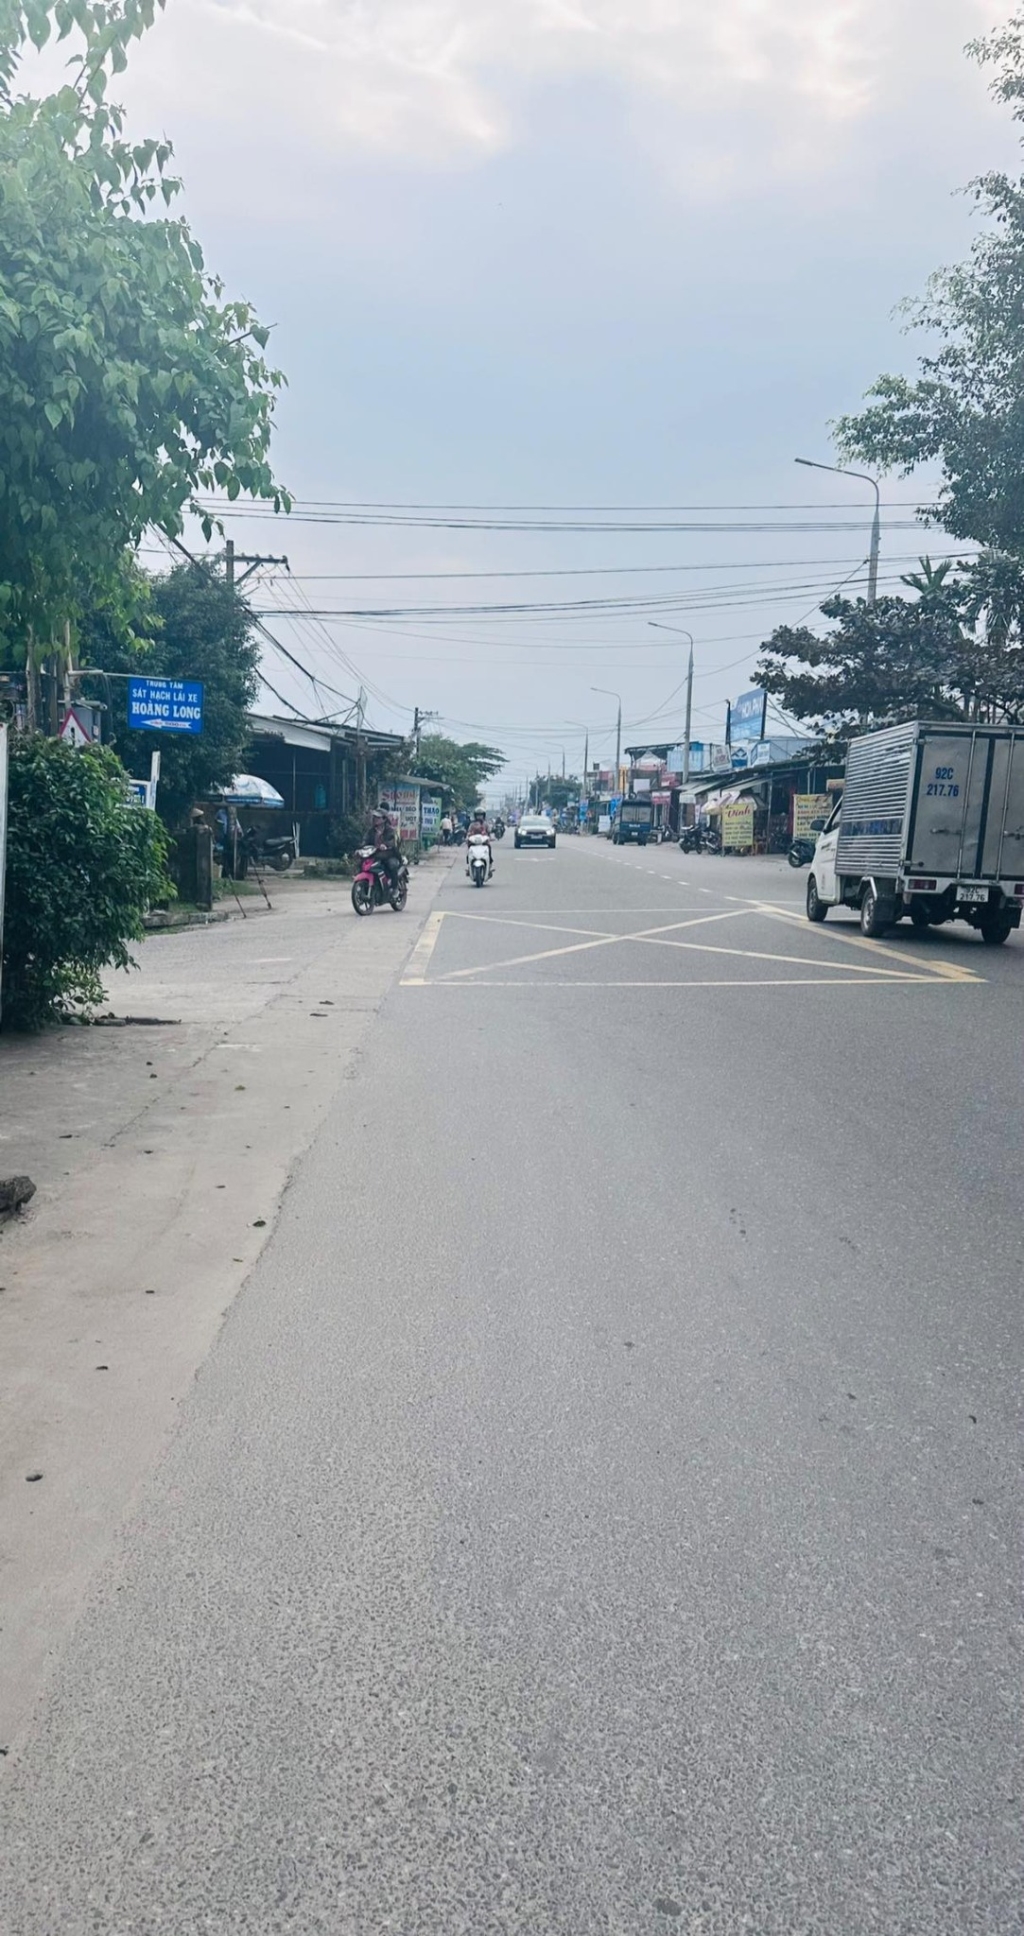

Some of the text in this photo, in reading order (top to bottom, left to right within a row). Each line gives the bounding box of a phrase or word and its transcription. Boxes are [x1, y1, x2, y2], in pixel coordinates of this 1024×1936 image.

[146, 680, 183, 689] TRUNG TÂM
[132, 687, 198, 703] SÁT HẠCH LÁI XE
[131, 700, 201, 720] HOÀNG LONG
[935, 766, 954, 780] 92C
[926, 783, 959, 798] 217.76
[959, 893, 986, 902] 217.76
